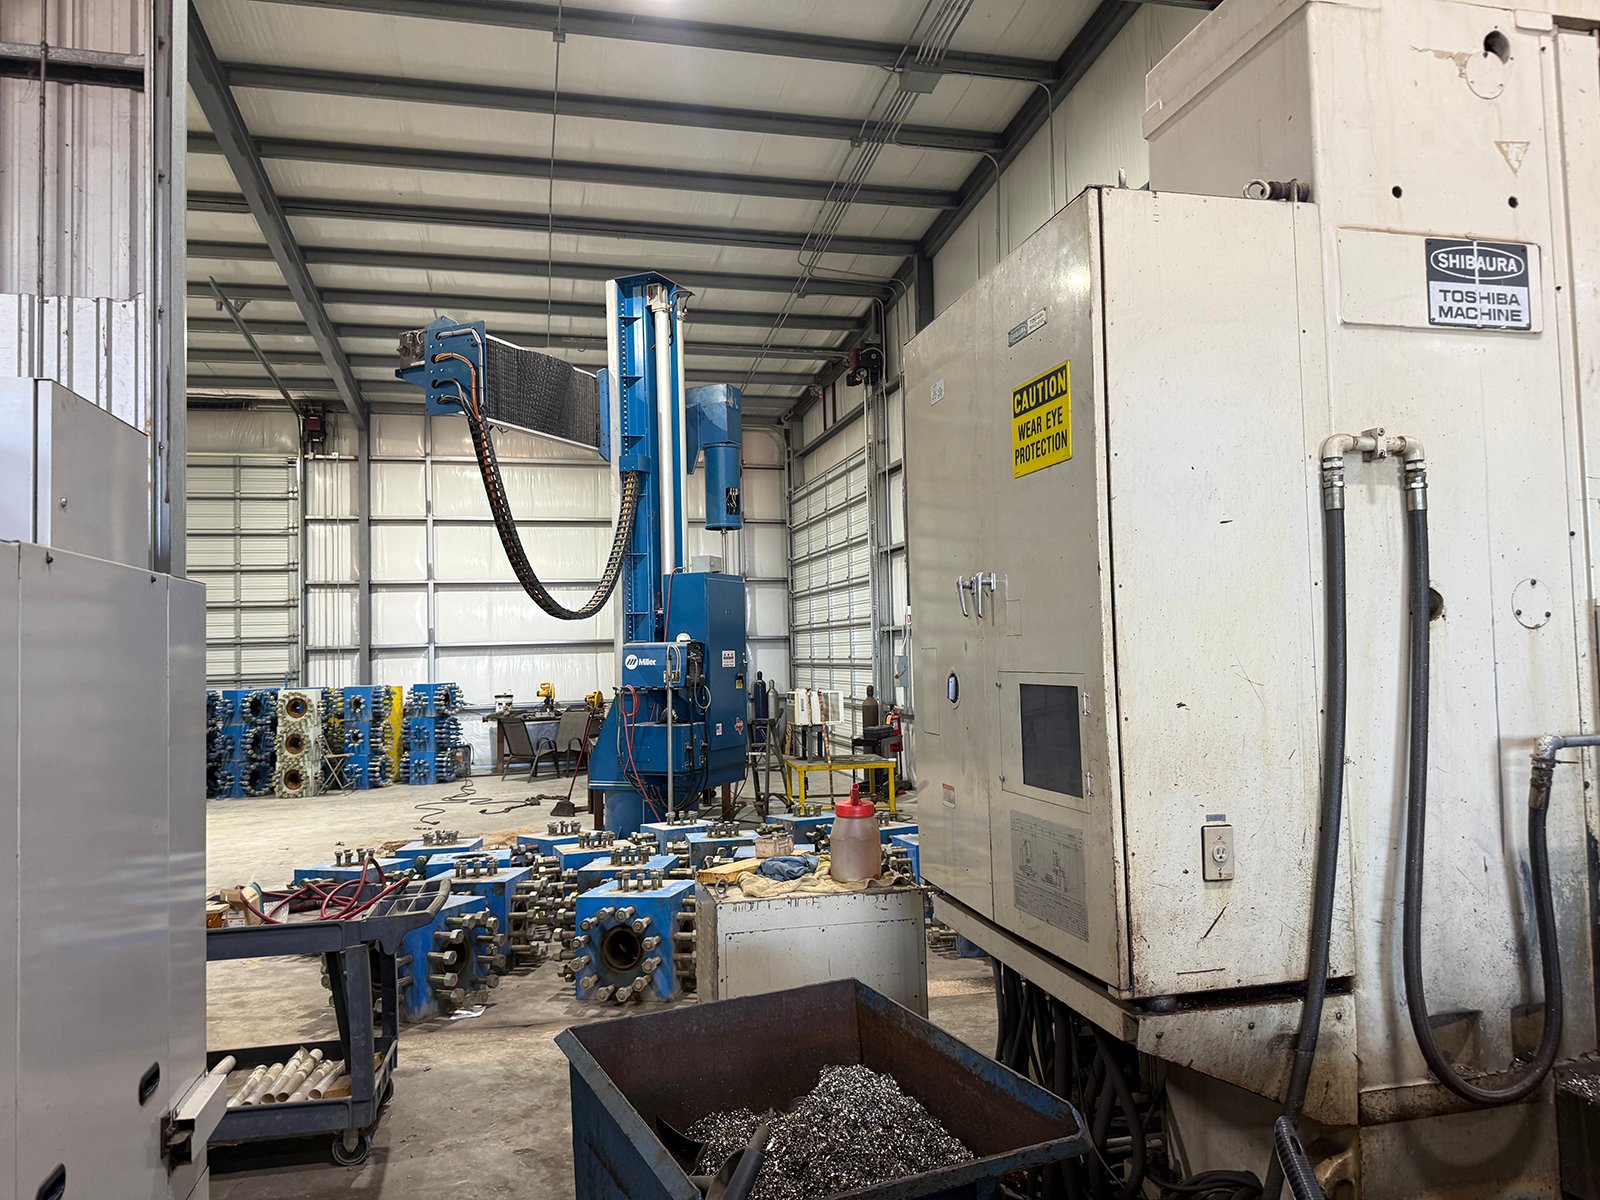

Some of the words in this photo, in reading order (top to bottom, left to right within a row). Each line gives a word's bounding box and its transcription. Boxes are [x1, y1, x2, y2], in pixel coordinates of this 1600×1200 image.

[1438, 254, 1518, 272] SHIBAURA
[1439, 289, 1520, 306] TOSHIBA
[1438, 305, 1522, 322] MACHINE
[1014, 369, 1067, 414] CAUTION
[1018, 416, 1042, 441] WEAR
[1046, 406, 1063, 430] EYE
[1015, 430, 1068, 466] PROTECTION
